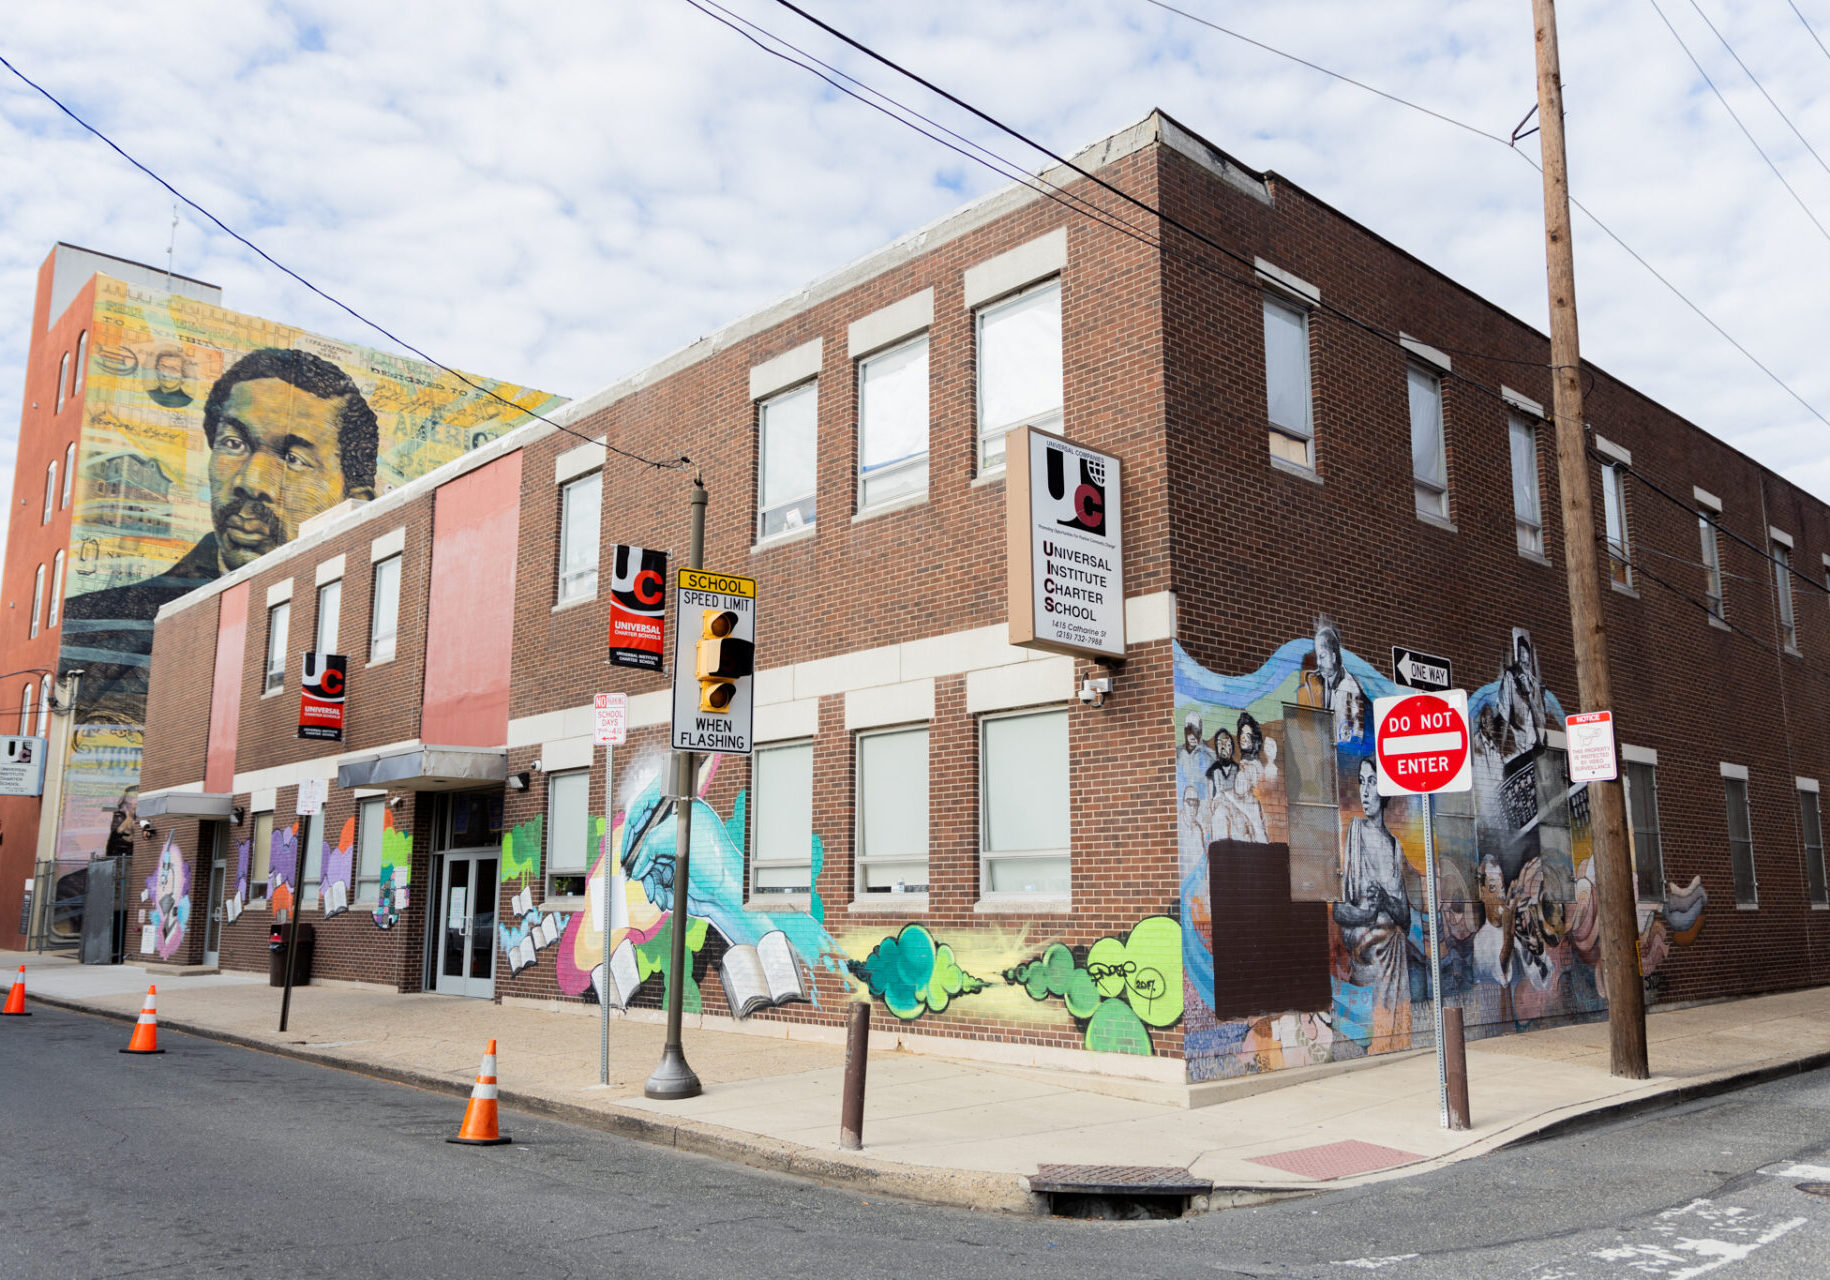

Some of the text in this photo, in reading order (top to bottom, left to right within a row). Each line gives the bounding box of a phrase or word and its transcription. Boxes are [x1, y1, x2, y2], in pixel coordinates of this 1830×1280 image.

[1046, 440, 1074, 456] UNIVERSAL
[1043, 540, 1112, 572] UNIVERSAL
[1046, 560, 1107, 588] INSTITUTE
[688, 574, 747, 595] SCHOOL
[1044, 578, 1103, 605] CHARTER
[683, 591, 750, 612] SPEED LIMIT
[1044, 596, 1097, 622] SCHOOL
[614, 620, 661, 635] UNIVERSAL
[1056, 630, 1073, 641] (215)
[1410, 662, 1446, 685] ONE WAY
[304, 705, 341, 715] UNIVERSAL
[596, 696, 606, 707] NO
[598, 710, 623, 719] SCHOOL
[601, 718, 618, 727] DAYS
[1388, 711, 1452, 733] DO NOT
[1577, 713, 1600, 722] NOTICE
[695, 717, 732, 733] WHEN
[680, 731, 745, 749] FLASHING
[1397, 756, 1449, 775] ENTER
